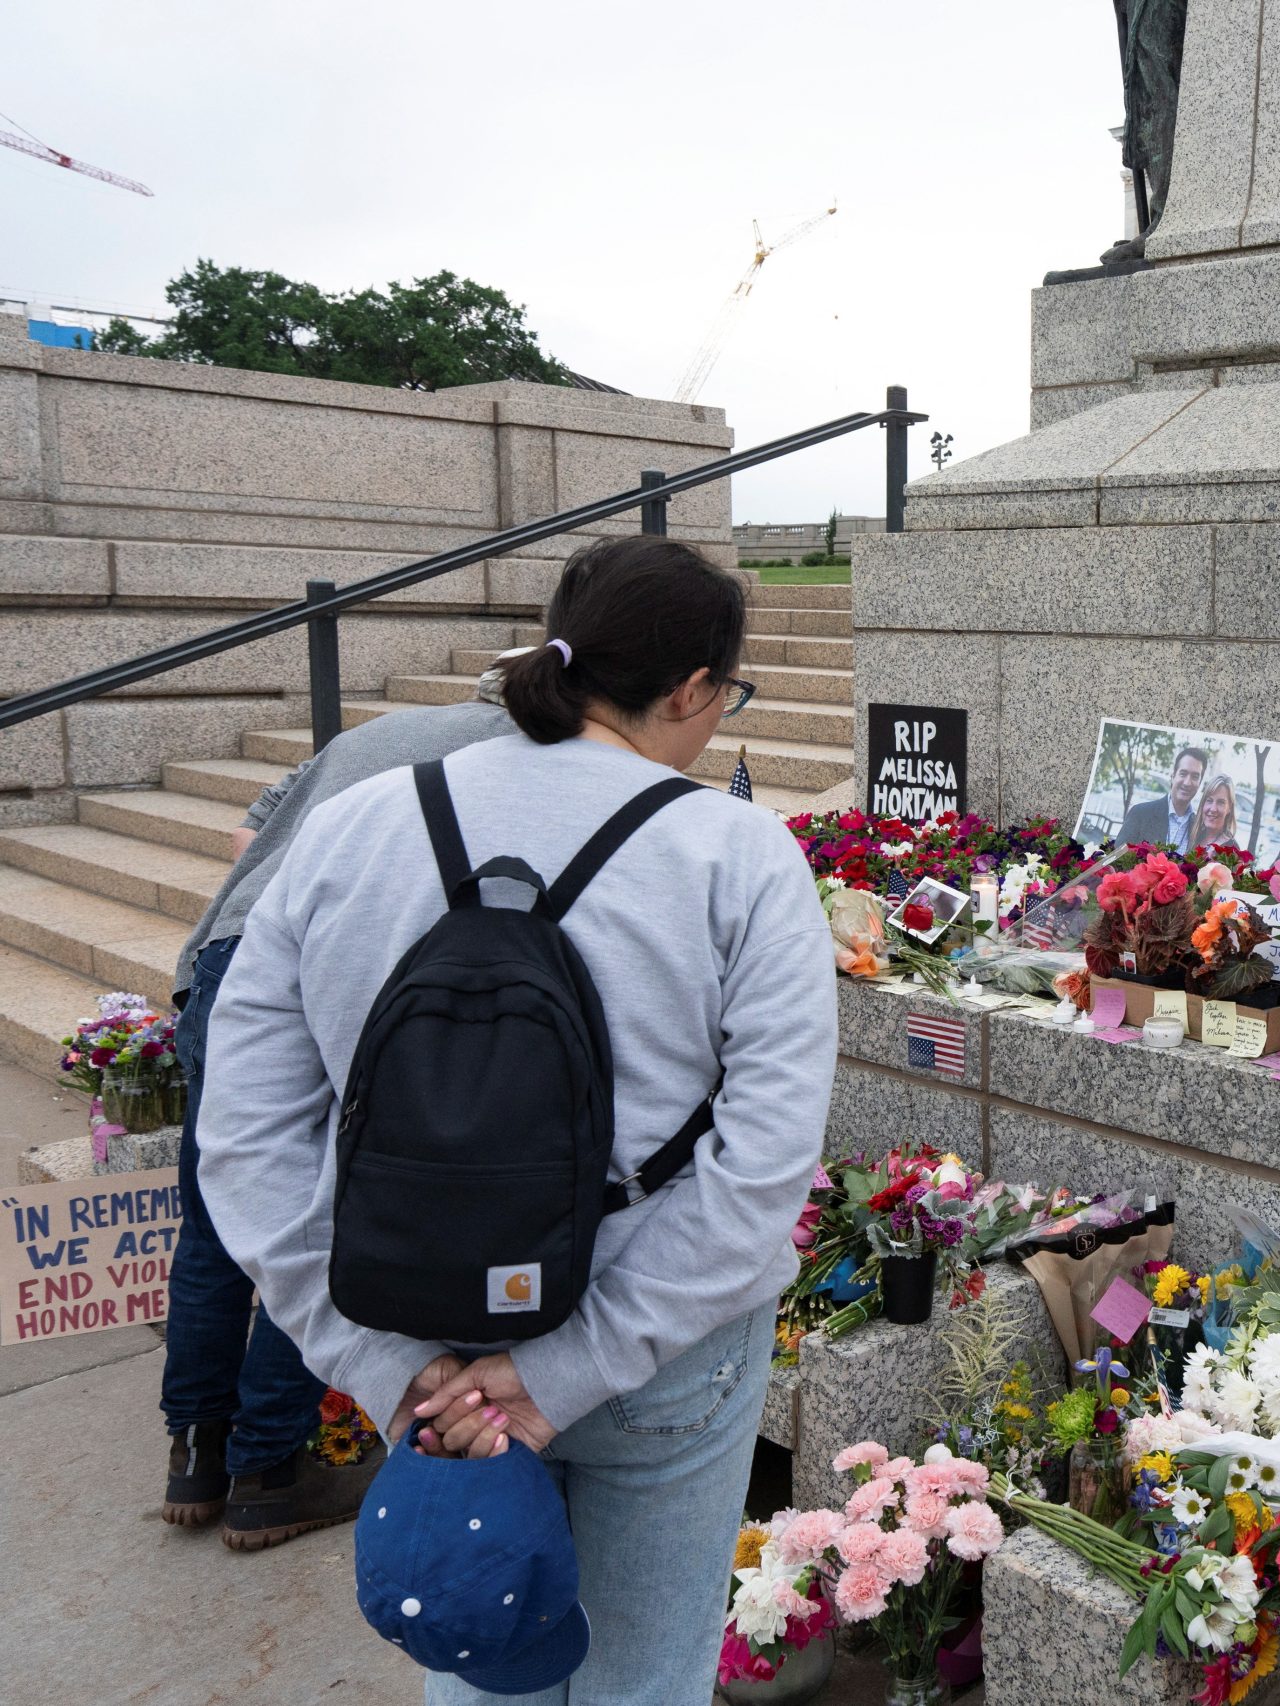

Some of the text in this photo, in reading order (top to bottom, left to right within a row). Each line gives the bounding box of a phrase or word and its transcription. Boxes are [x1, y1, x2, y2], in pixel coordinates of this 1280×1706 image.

[894, 720, 937, 754] RIP
[878, 756, 958, 790] MELISSA
[873, 783, 958, 821] HORTMAN
[26, 1227, 177, 1270] WE ACT
[18, 1272, 93, 1310] END
[15, 1299, 119, 1340] HONOR
